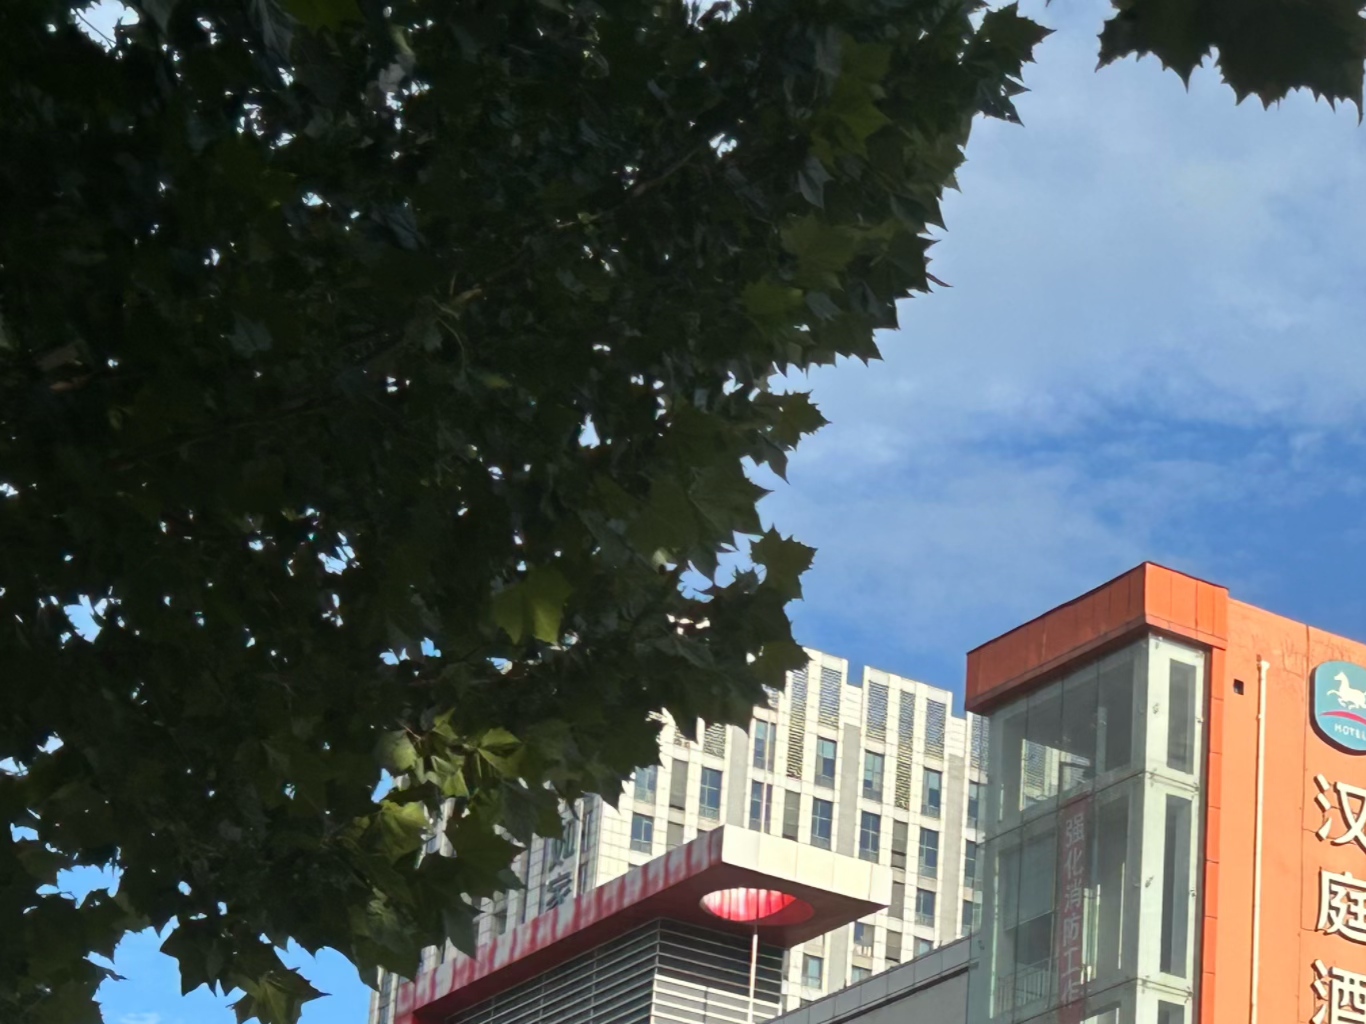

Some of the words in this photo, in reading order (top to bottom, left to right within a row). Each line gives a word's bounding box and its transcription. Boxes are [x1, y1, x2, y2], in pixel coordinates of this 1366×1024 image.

[1062, 811, 1086, 1008] 强化消防工作
